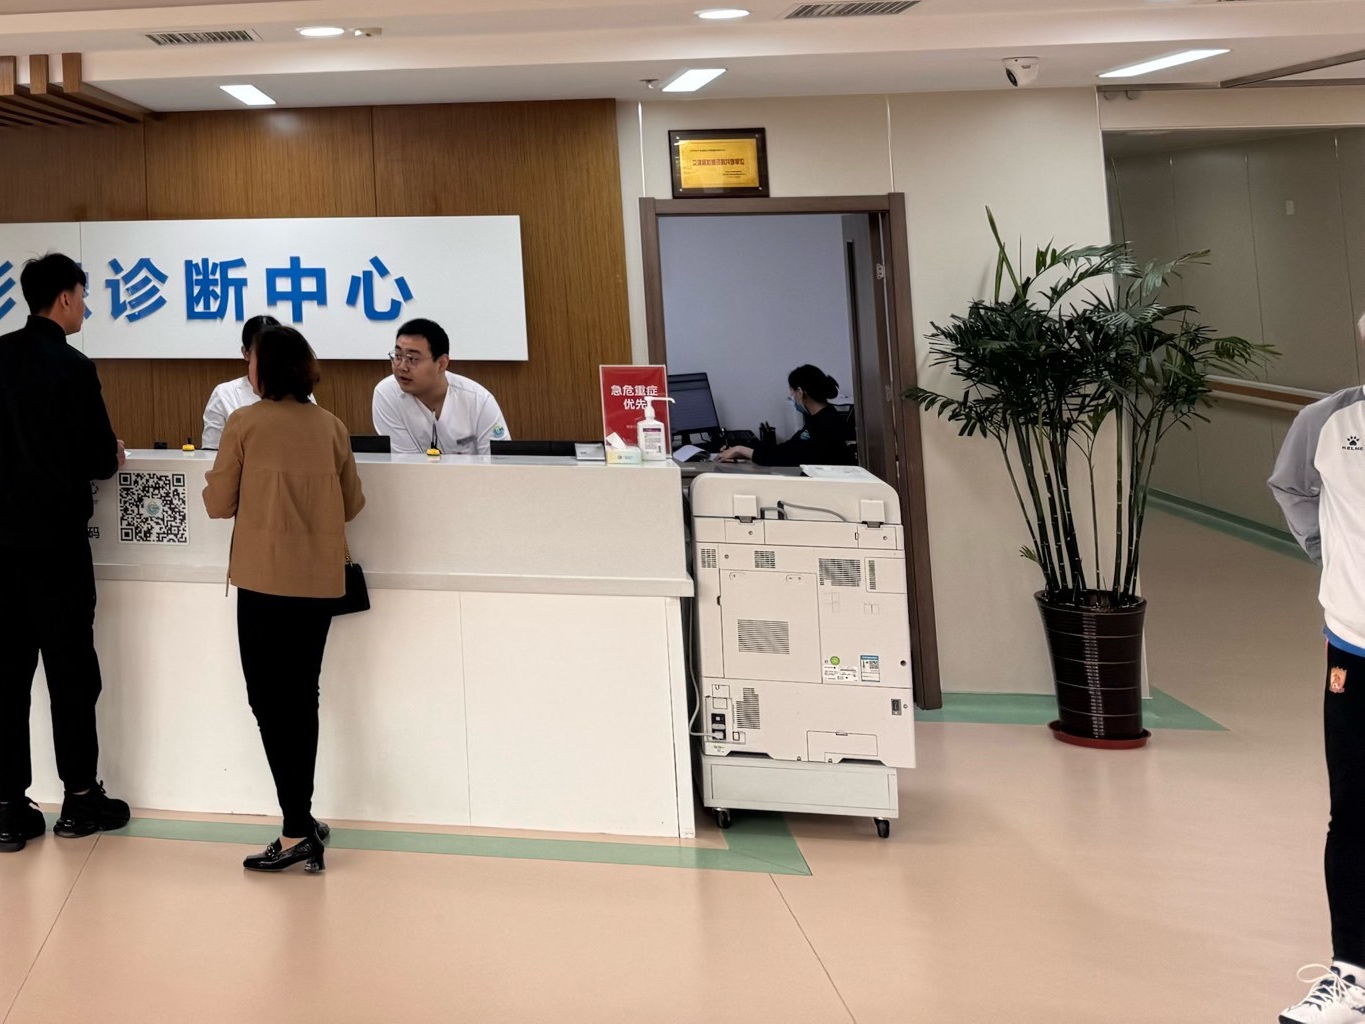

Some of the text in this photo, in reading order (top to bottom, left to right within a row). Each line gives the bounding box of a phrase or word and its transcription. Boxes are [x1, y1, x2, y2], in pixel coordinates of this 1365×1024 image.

[610, 384, 658, 396] 急危重症
[623, 398, 647, 410] 优先
